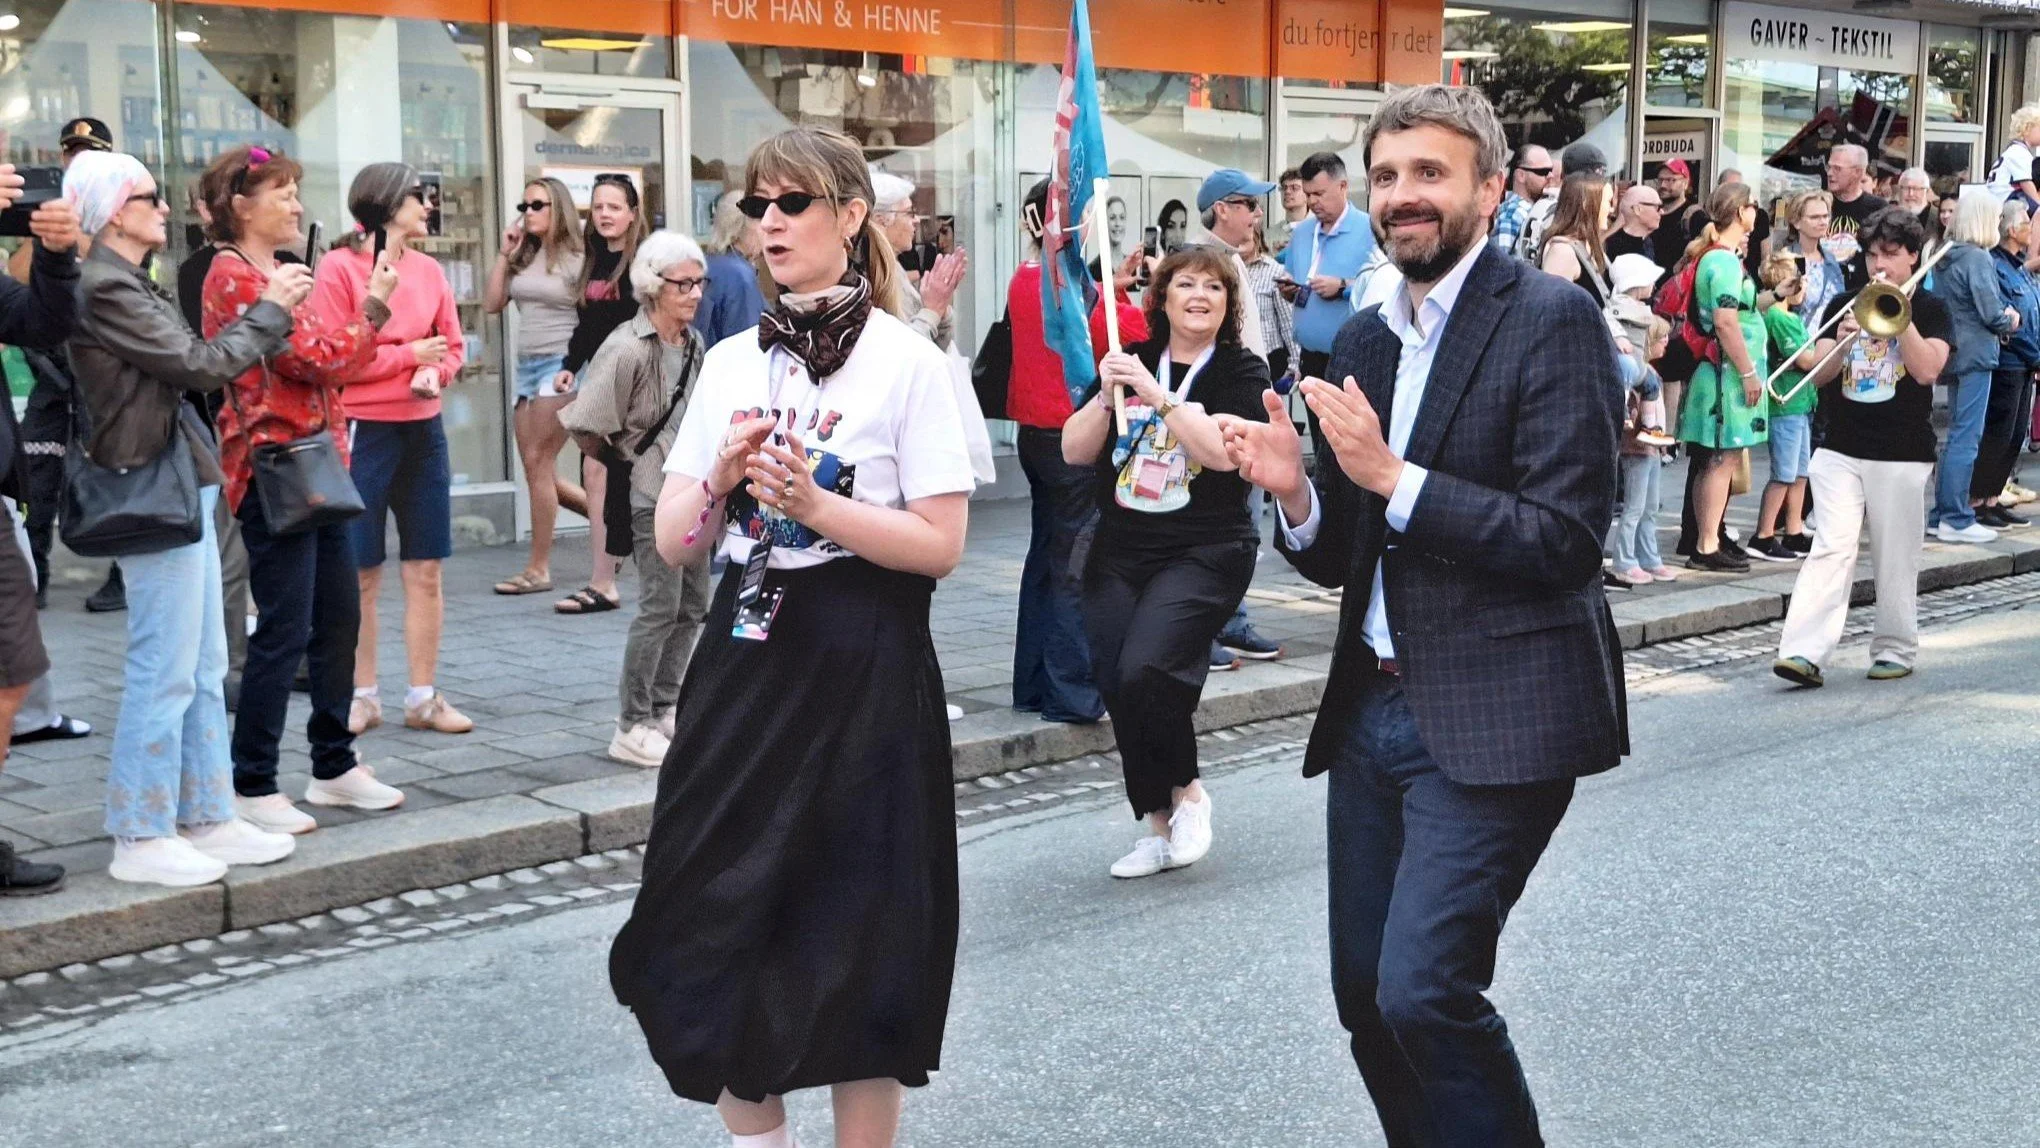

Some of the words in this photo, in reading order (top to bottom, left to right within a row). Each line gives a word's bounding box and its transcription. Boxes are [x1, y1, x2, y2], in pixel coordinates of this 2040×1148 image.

[712, 0, 758, 21] FOR
[769, 0, 822, 26] HAN
[833, 0, 852, 28] &
[863, 5, 942, 35] HENNE
[1283, 17, 1308, 46] du
[1404, 25, 1433, 54] det
[1750, 18, 1809, 51] GAVER
[1831, 26, 1894, 59] TEKSTIL
